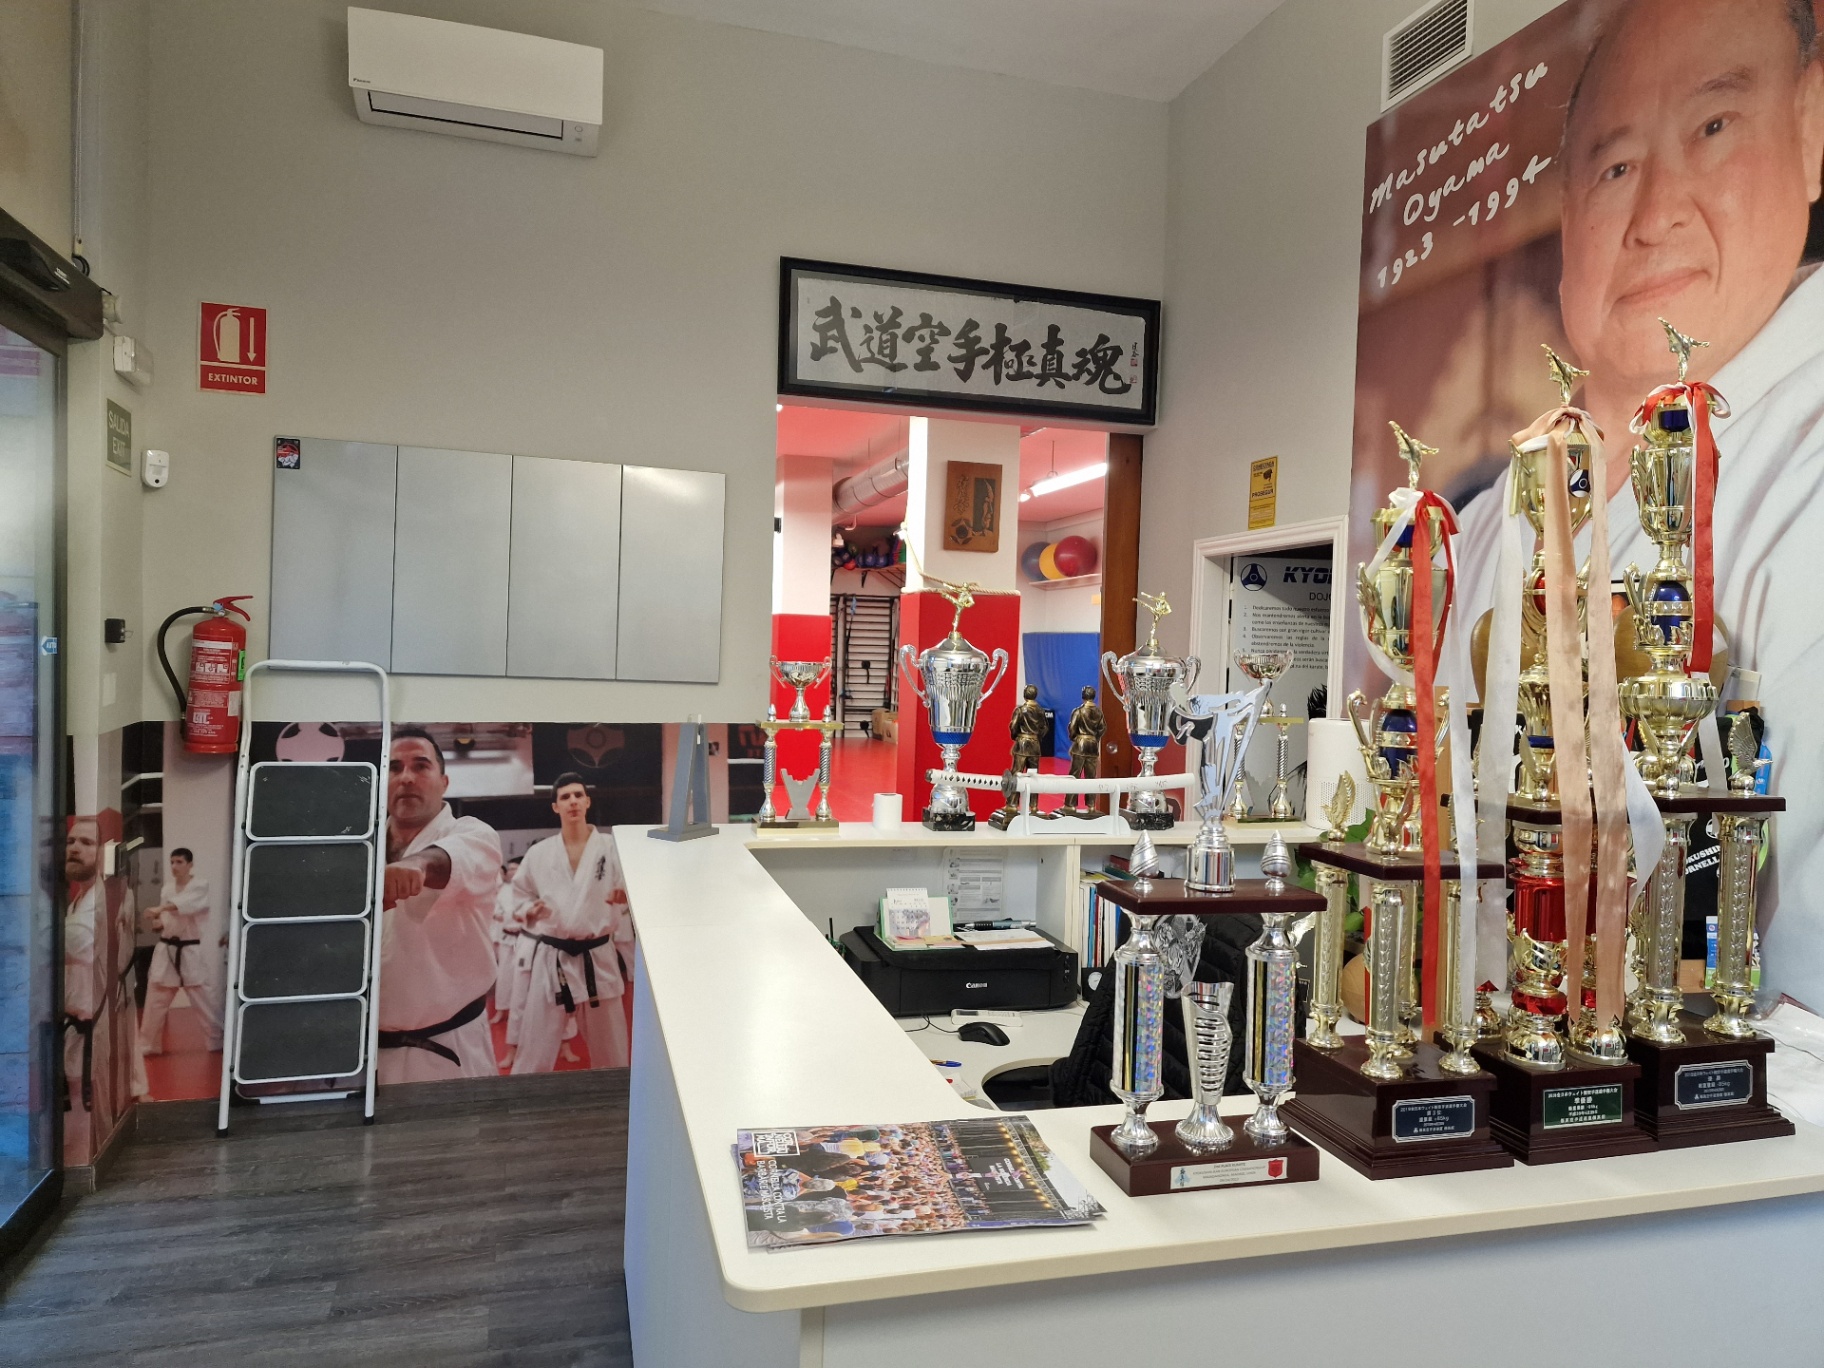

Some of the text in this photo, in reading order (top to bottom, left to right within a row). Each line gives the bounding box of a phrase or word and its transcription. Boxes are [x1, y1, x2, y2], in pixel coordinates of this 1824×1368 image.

[1369, 62, 1548, 214] Masutatsu
[1403, 141, 1510, 226] Oyama
[1377, 231, 1433, 288] 1923
[208, 372, 258, 386] EXTINTOR
[108, 410, 130, 438] SALIDA
